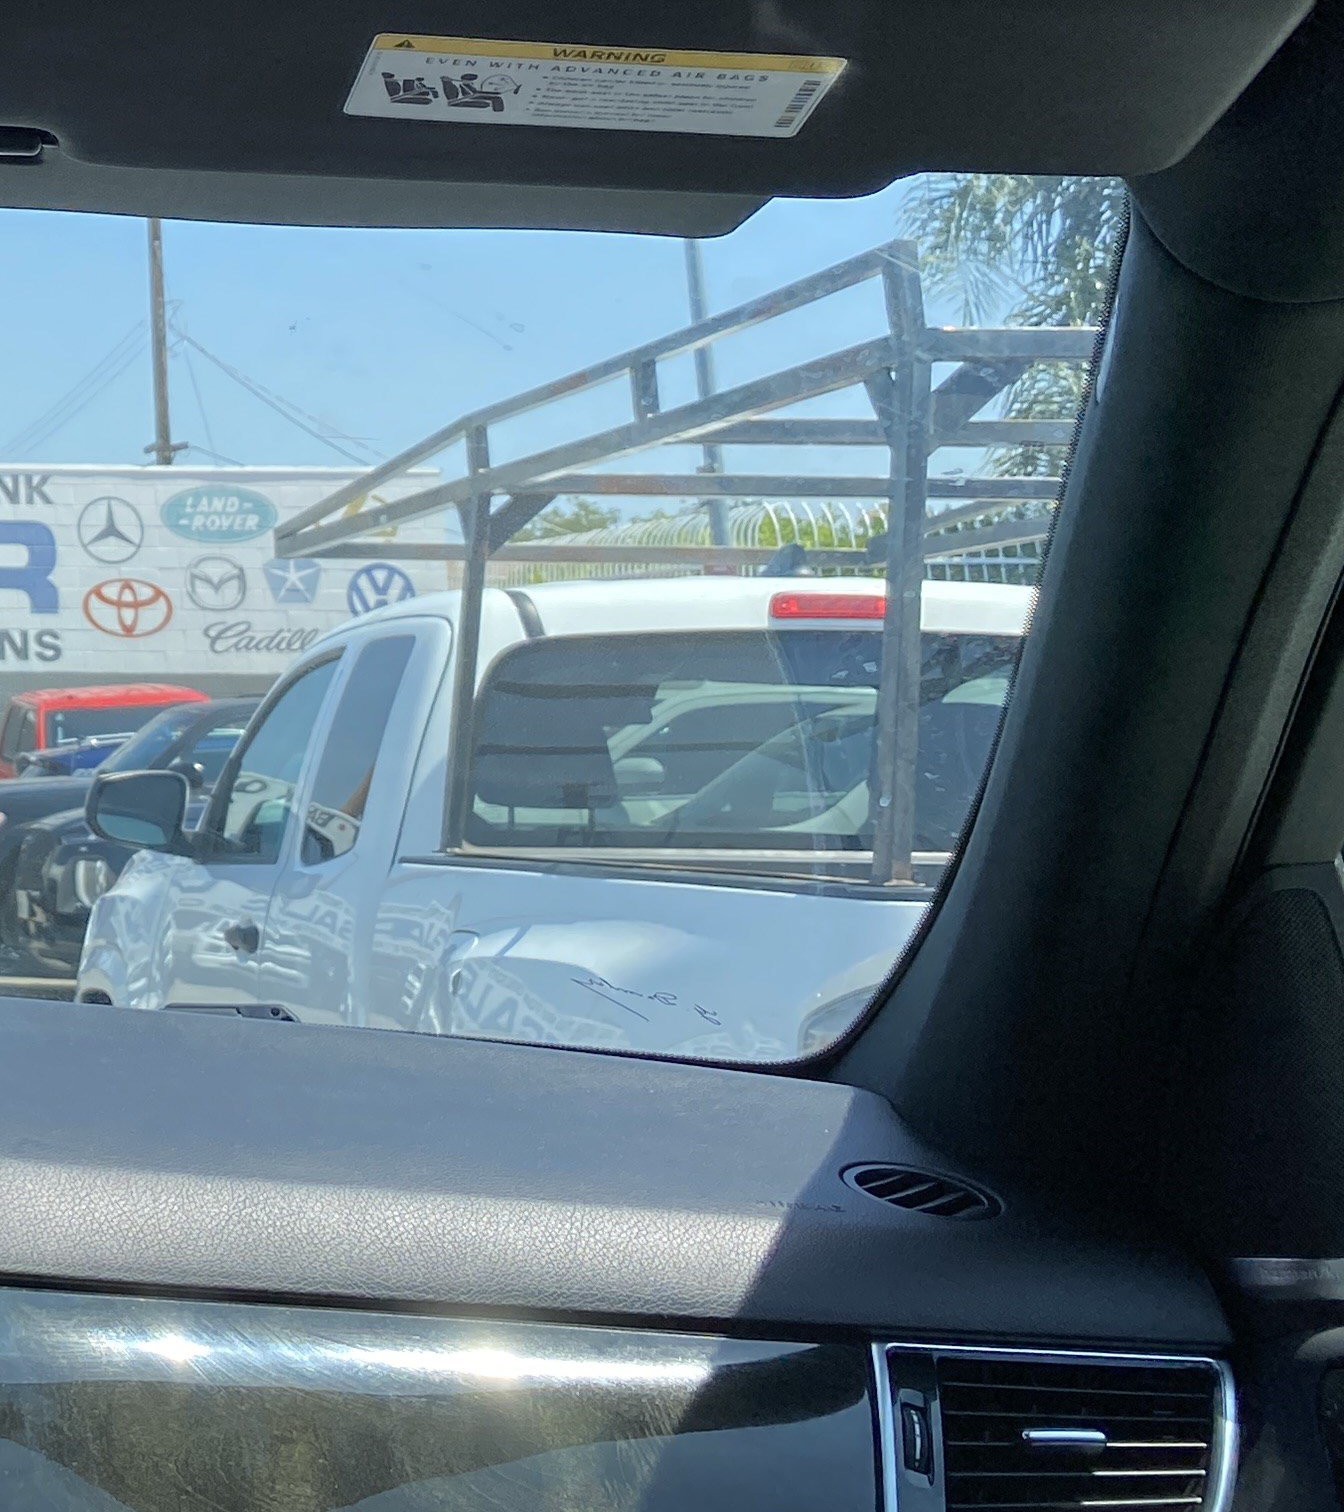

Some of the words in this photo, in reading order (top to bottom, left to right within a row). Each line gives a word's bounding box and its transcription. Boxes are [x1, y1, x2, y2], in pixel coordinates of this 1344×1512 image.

[553, 47, 668, 63] WARNING
[425, 56, 477, 68] EVEN
[489, 60, 541, 71] WITH
[550, 64, 663, 78] ADVANCED
[672, 71, 707, 80] AIR
[716, 74, 771, 83] BAGS
[202, 620, 320, 654] Cadill
